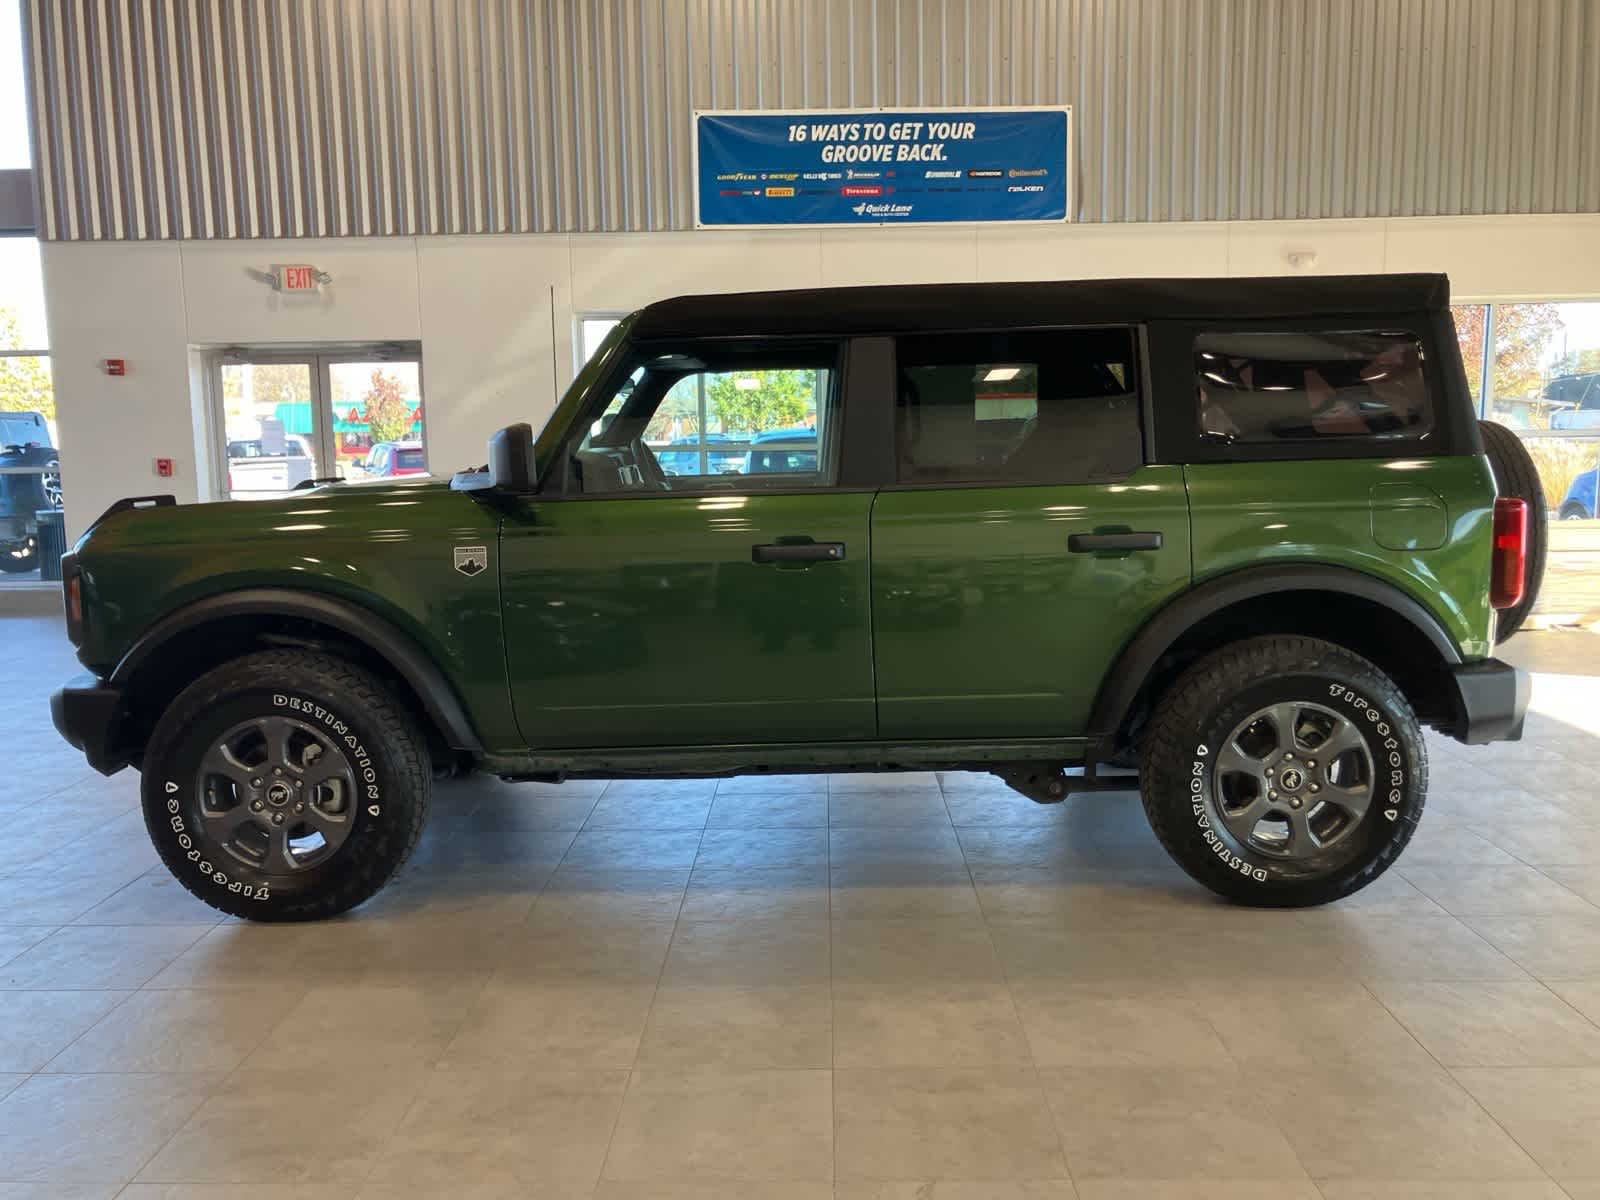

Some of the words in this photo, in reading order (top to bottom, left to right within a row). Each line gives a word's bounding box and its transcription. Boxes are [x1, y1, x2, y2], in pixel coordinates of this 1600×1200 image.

[788, 125, 807, 142] 16
[811, 124, 860, 141] WAYS
[864, 124, 885, 141] TO
[889, 122, 924, 140] GET
[928, 122, 976, 139] YOUR
[821, 145, 894, 162] GROOVE
[896, 143, 947, 161] BACK.
[1007, 185, 1043, 193] FALKEN
[865, 204, 890, 213] Quick
[891, 204, 912, 212] Lane
[287, 268, 312, 288] EXIT
[273, 694, 380, 799] DESTINATION
[1329, 683, 1403, 803] Firestone
[1190, 761, 1268, 881] DESTINATION
